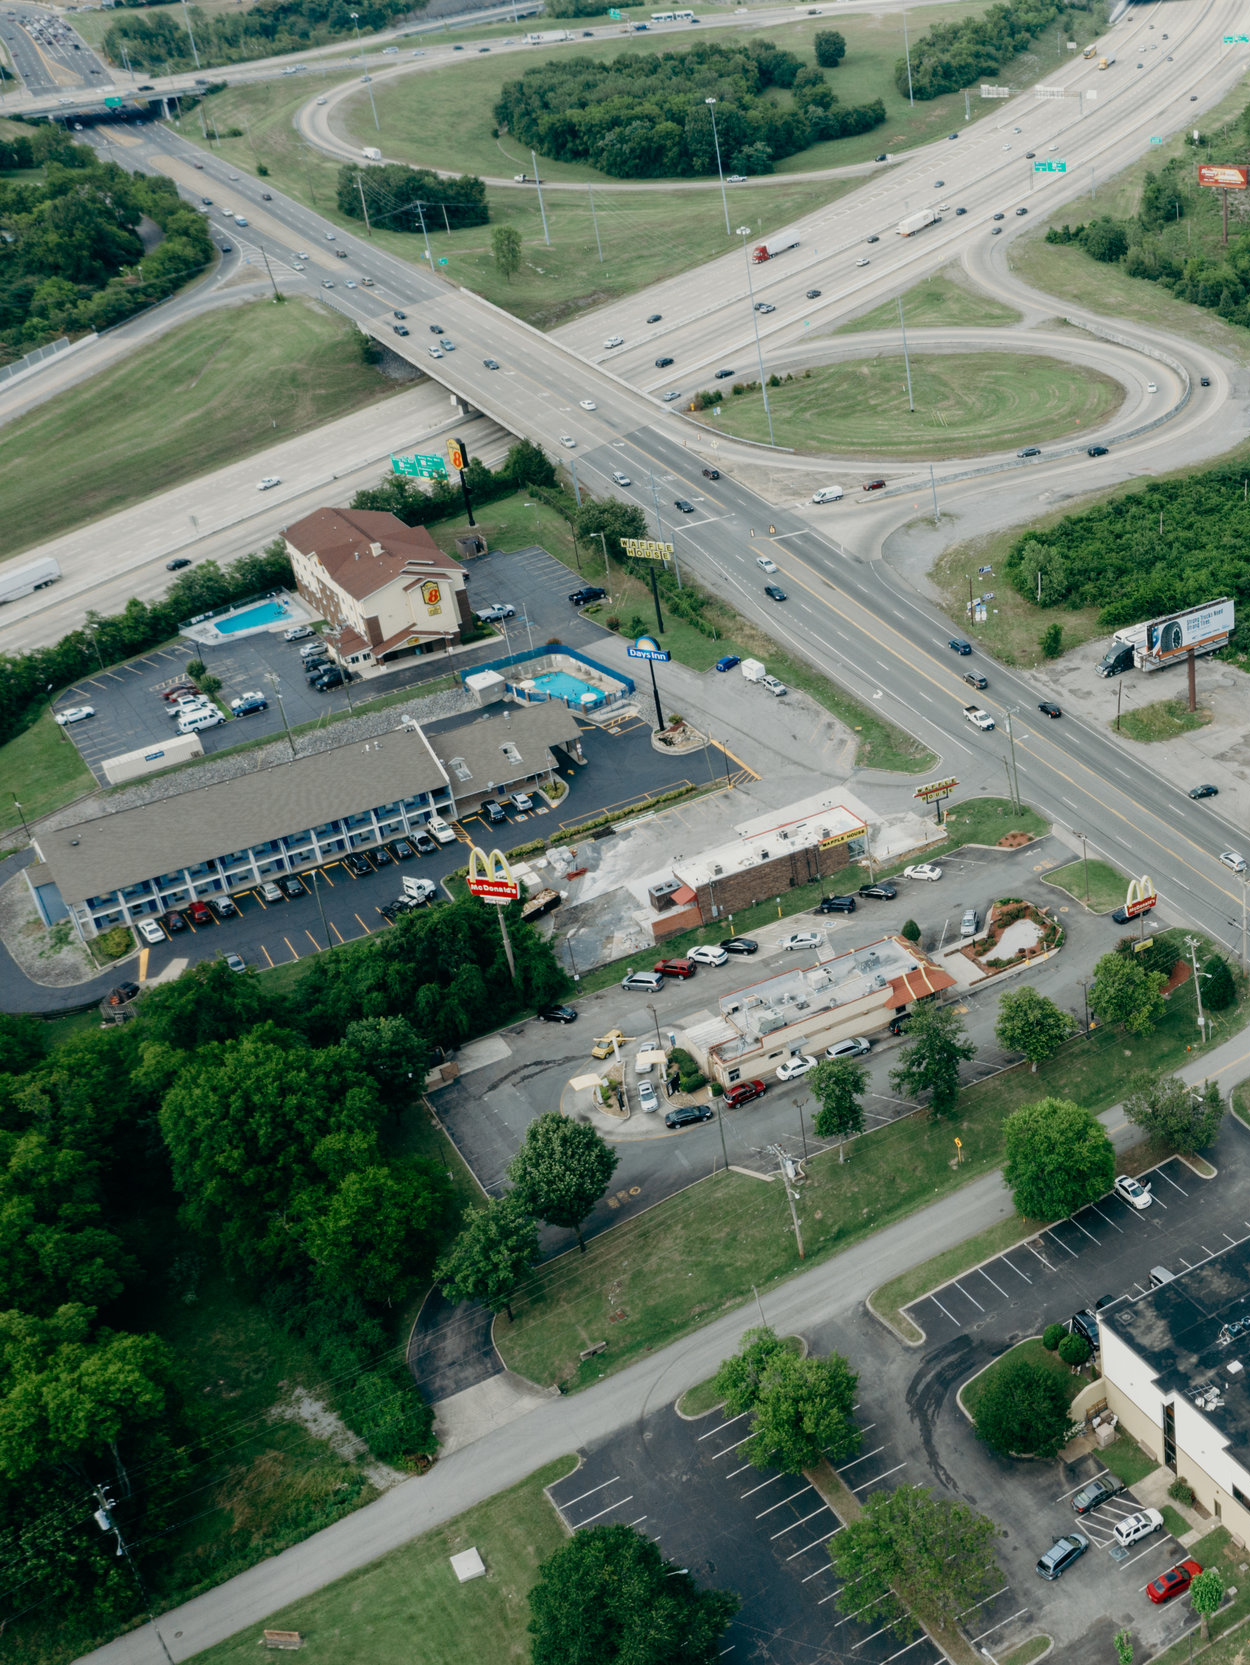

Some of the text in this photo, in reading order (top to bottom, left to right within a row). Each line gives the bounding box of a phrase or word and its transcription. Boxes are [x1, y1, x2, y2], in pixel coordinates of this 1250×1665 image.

[453, 451, 462, 468] 8
[621, 539, 672, 552] WAFFLE
[627, 549, 669, 560] HOUSE
[428, 589, 439, 603] 8
[630, 649, 666, 660] Days Inn
[917, 778, 956, 793] WAFFLE
[822, 836, 845, 848] WAFFLE
[470, 883, 517, 895] McDonald's
[1129, 899, 1156, 913] McDonald's
